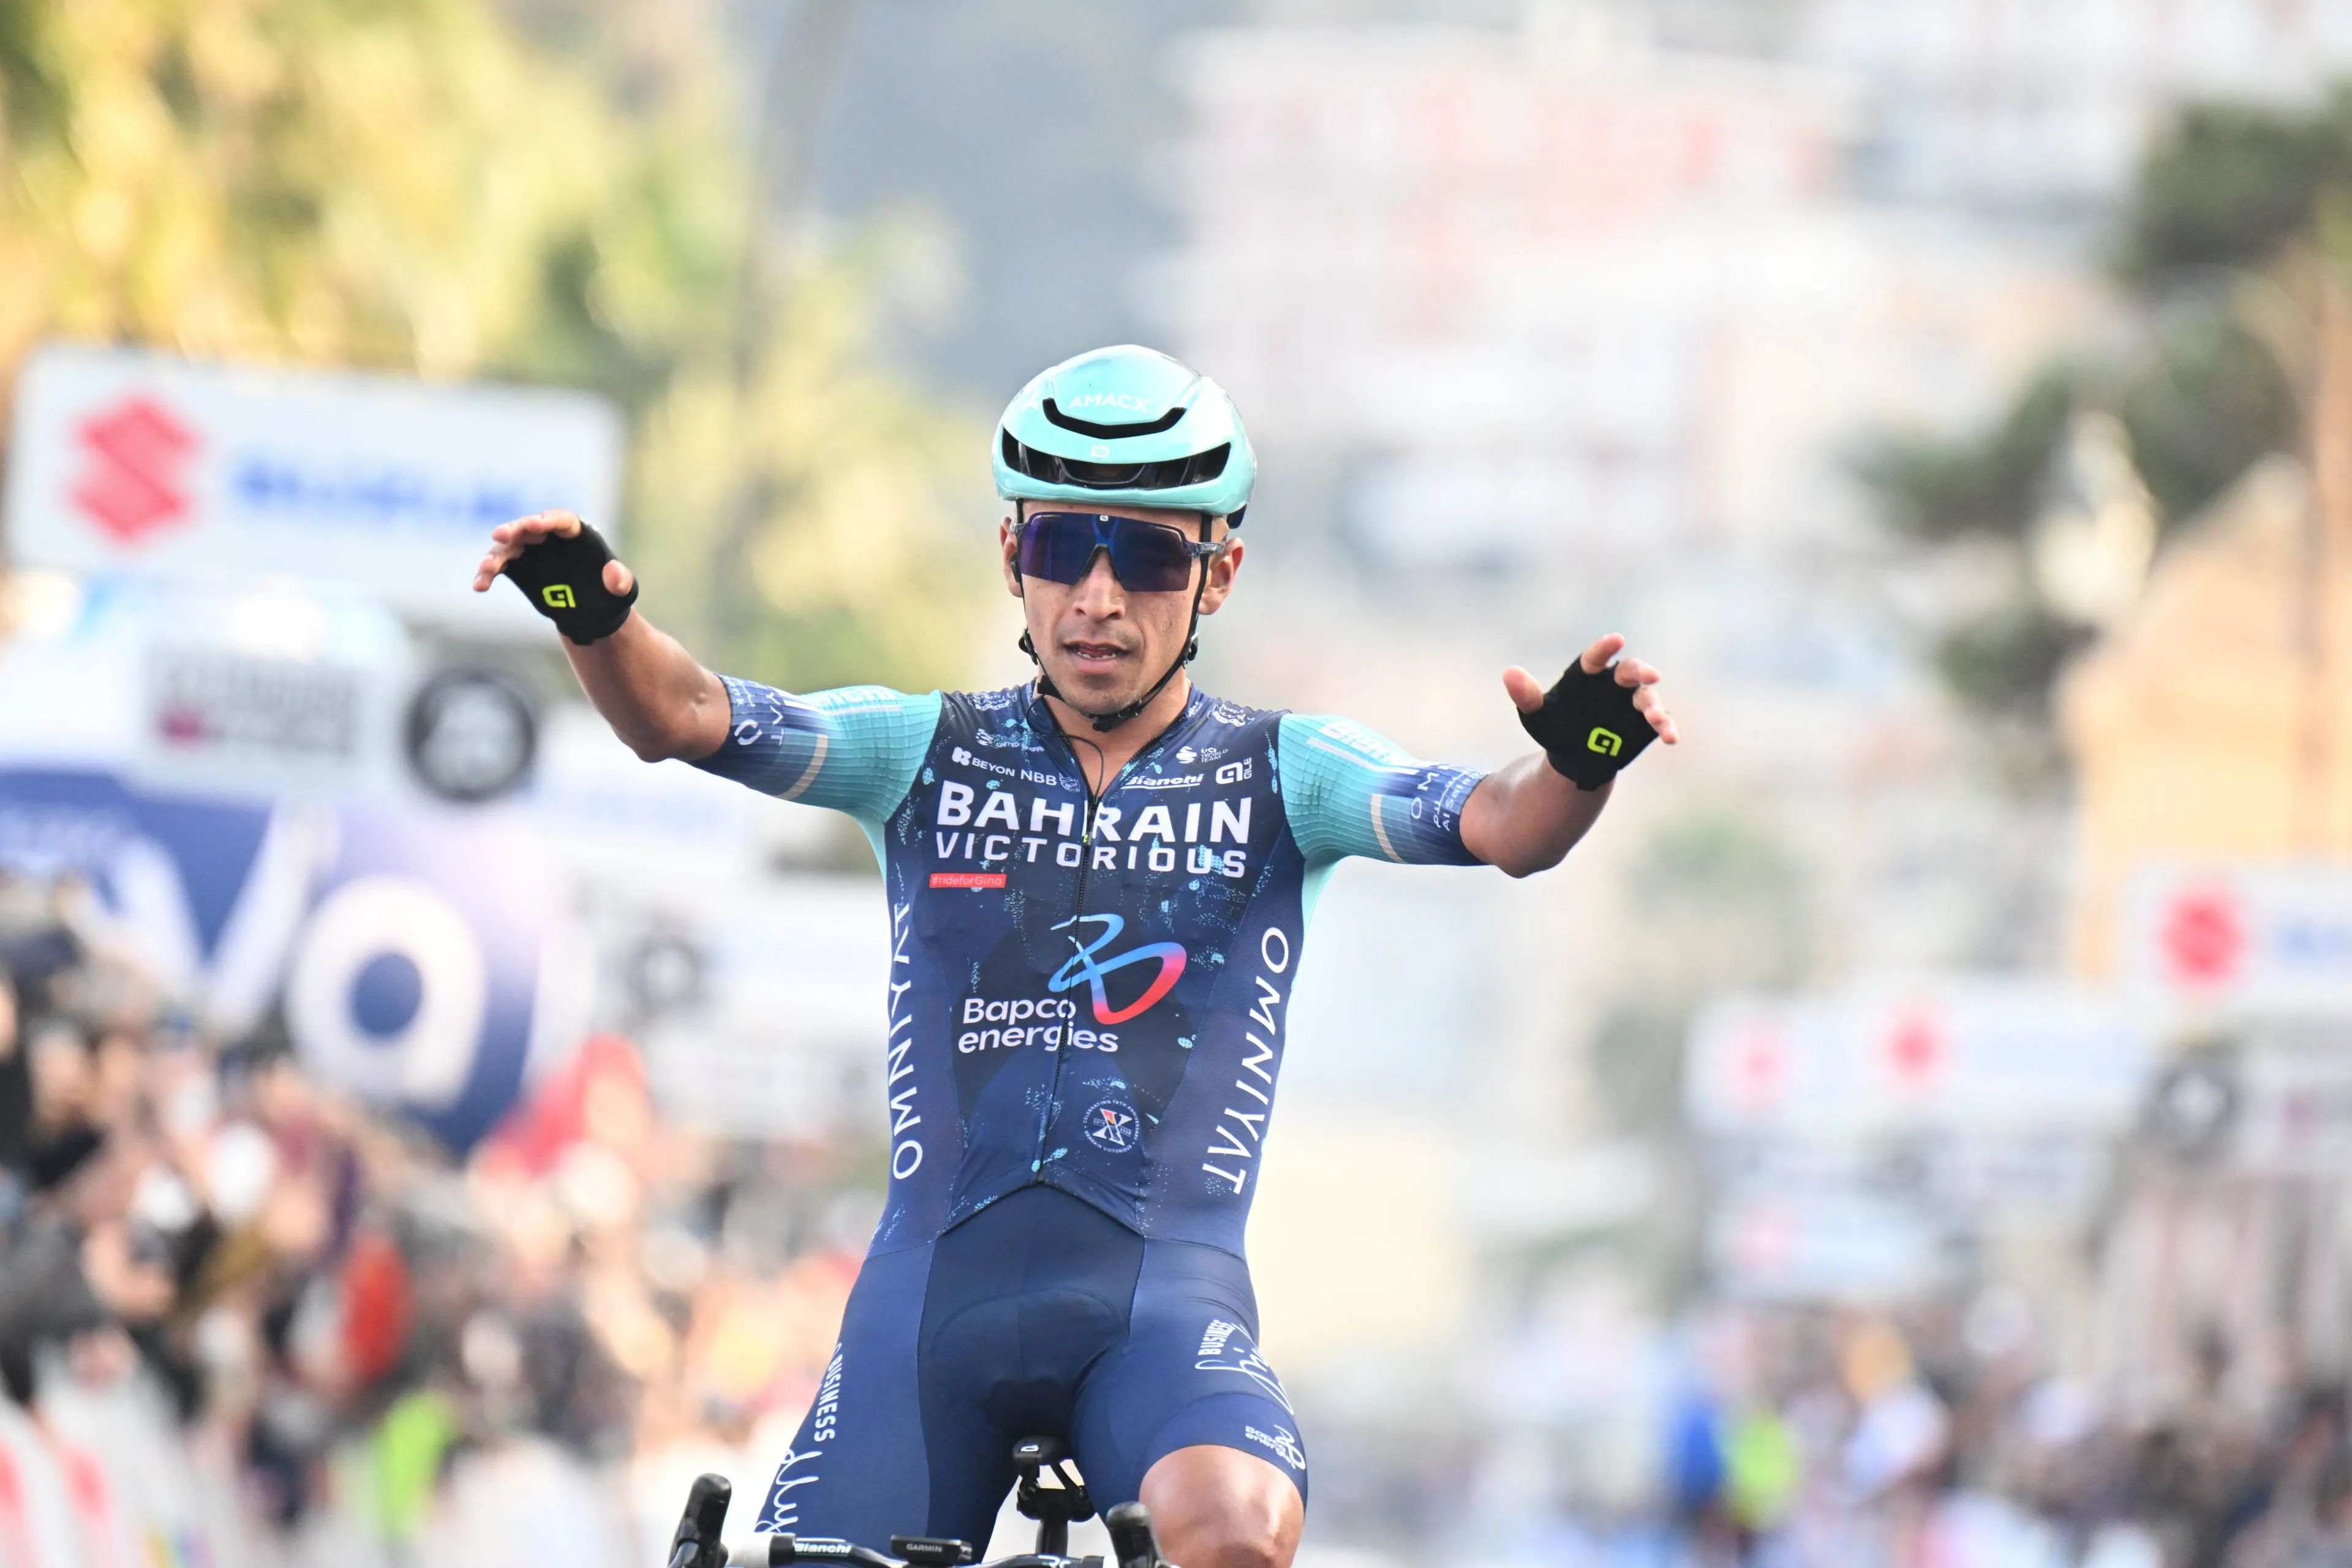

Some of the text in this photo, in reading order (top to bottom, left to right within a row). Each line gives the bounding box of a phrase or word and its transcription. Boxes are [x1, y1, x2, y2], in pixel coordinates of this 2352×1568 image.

[1068, 393, 1151, 413] AMACX
[971, 757, 1057, 786] BEYON NBB
[937, 780, 1252, 844] BAHRAIN
[936, 831, 1246, 878] VICTORIOUS
[932, 875, 1003, 886] #rideforGino
[963, 998, 1076, 1026] Bapco
[888, 903, 923, 1180] OMNIYAT
[958, 1020, 1119, 1054] energies
[1202, 927, 1289, 1195] OMNIYAT
[1084, 1130, 1102, 1148] BAHRAIN
[813, 1354, 843, 1442] BUSINESS
[794, 1542, 852, 1554] Bianchi
[906, 1543, 943, 1554] GARMIN
